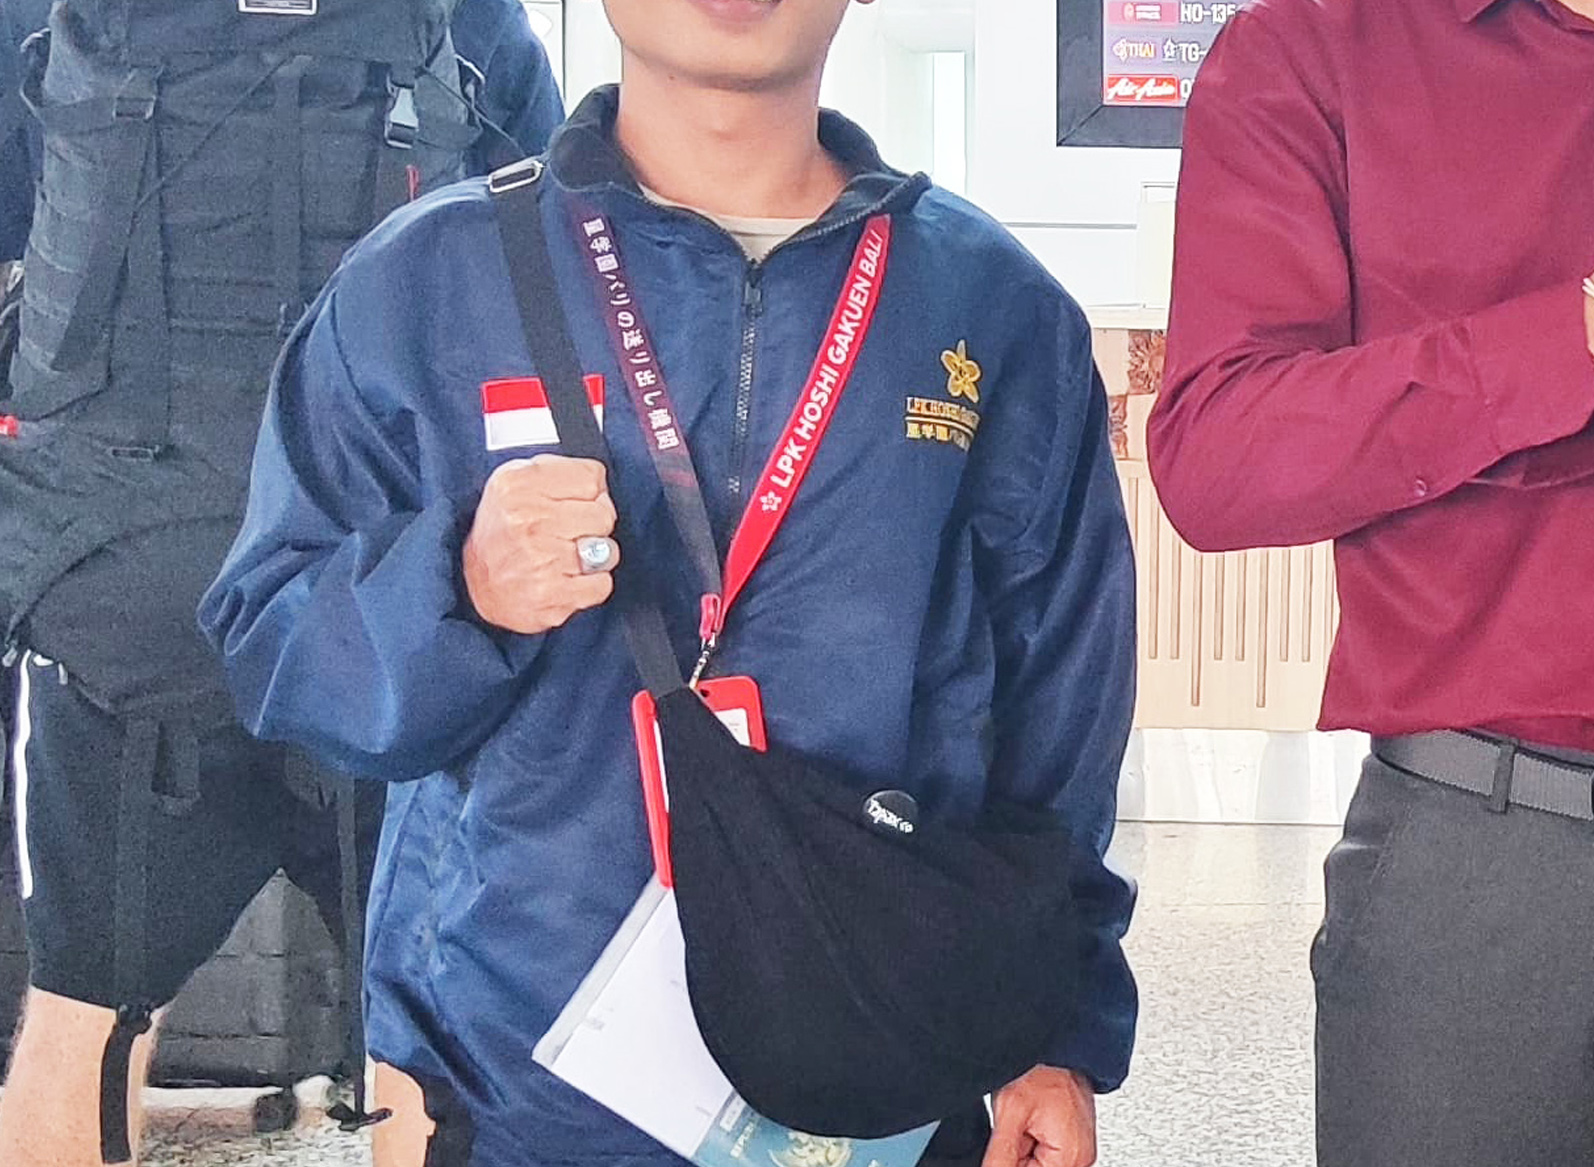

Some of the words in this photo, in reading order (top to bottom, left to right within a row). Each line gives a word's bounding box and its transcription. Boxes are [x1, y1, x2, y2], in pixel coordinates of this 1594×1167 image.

[769, 438, 807, 488] LPK
[793, 363, 840, 441] HOSHI
[826, 274, 873, 366] GAKUEN
[857, 228, 884, 278] BALI
